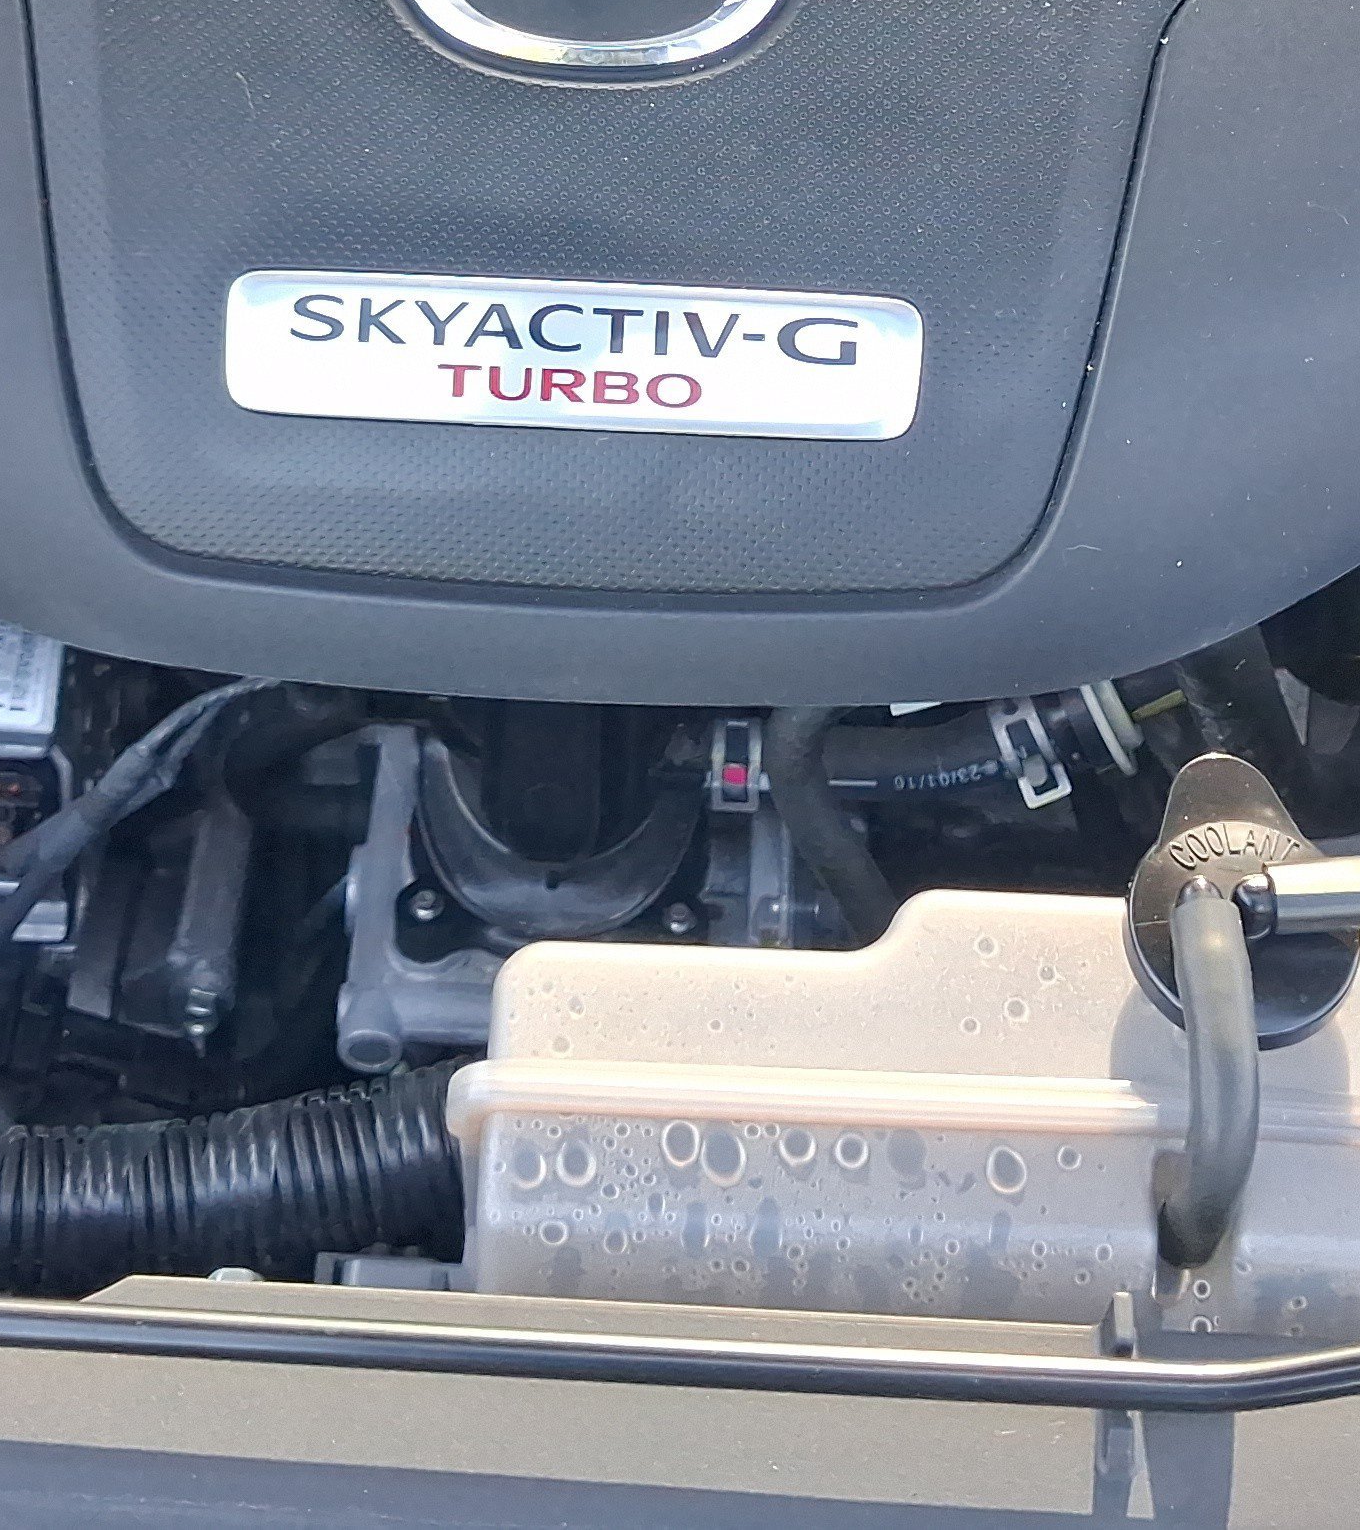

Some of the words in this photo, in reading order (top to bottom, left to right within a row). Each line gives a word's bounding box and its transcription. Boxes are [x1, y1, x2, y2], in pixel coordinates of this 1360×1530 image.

[289, 294, 860, 366] SKYACTIV-G
[437, 363, 702, 409] TURBO
[1168, 822, 1301, 871] COOLANT
